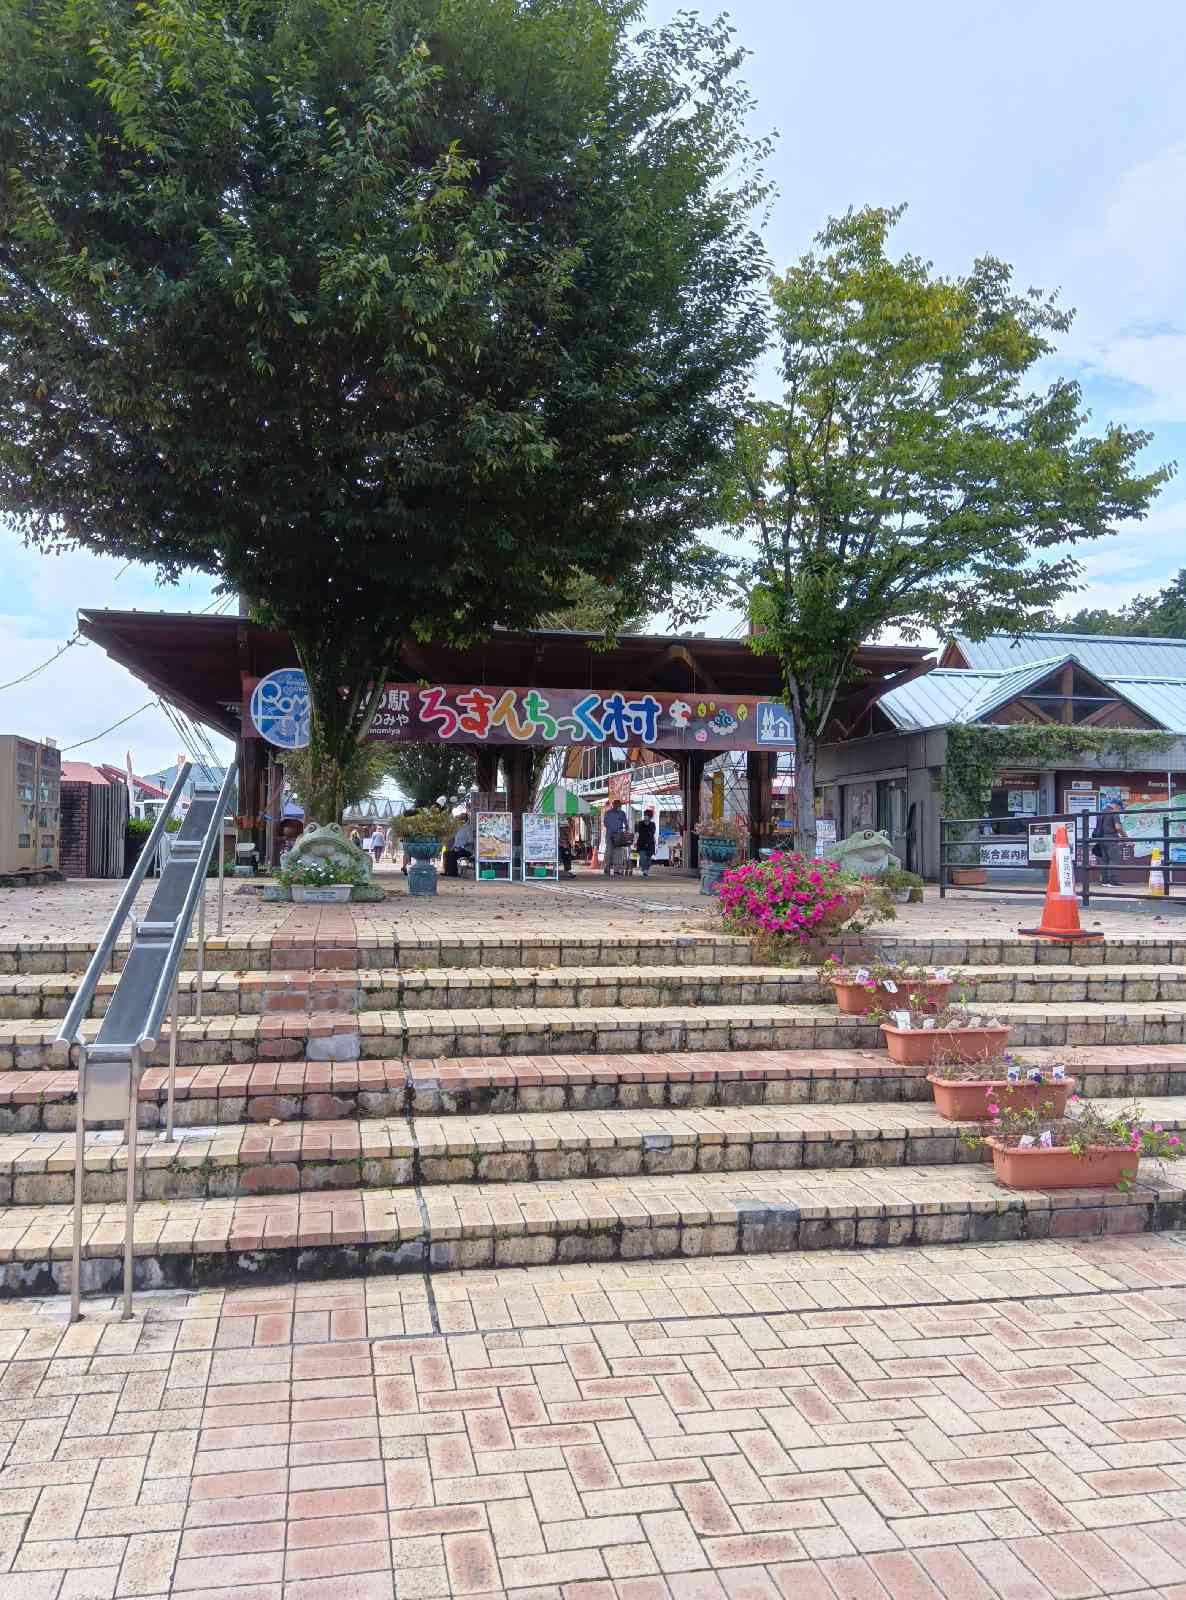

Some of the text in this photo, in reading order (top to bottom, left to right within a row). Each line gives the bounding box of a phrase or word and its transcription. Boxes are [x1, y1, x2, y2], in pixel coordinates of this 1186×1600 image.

[419, 687, 662, 743] ろまんちっく村
